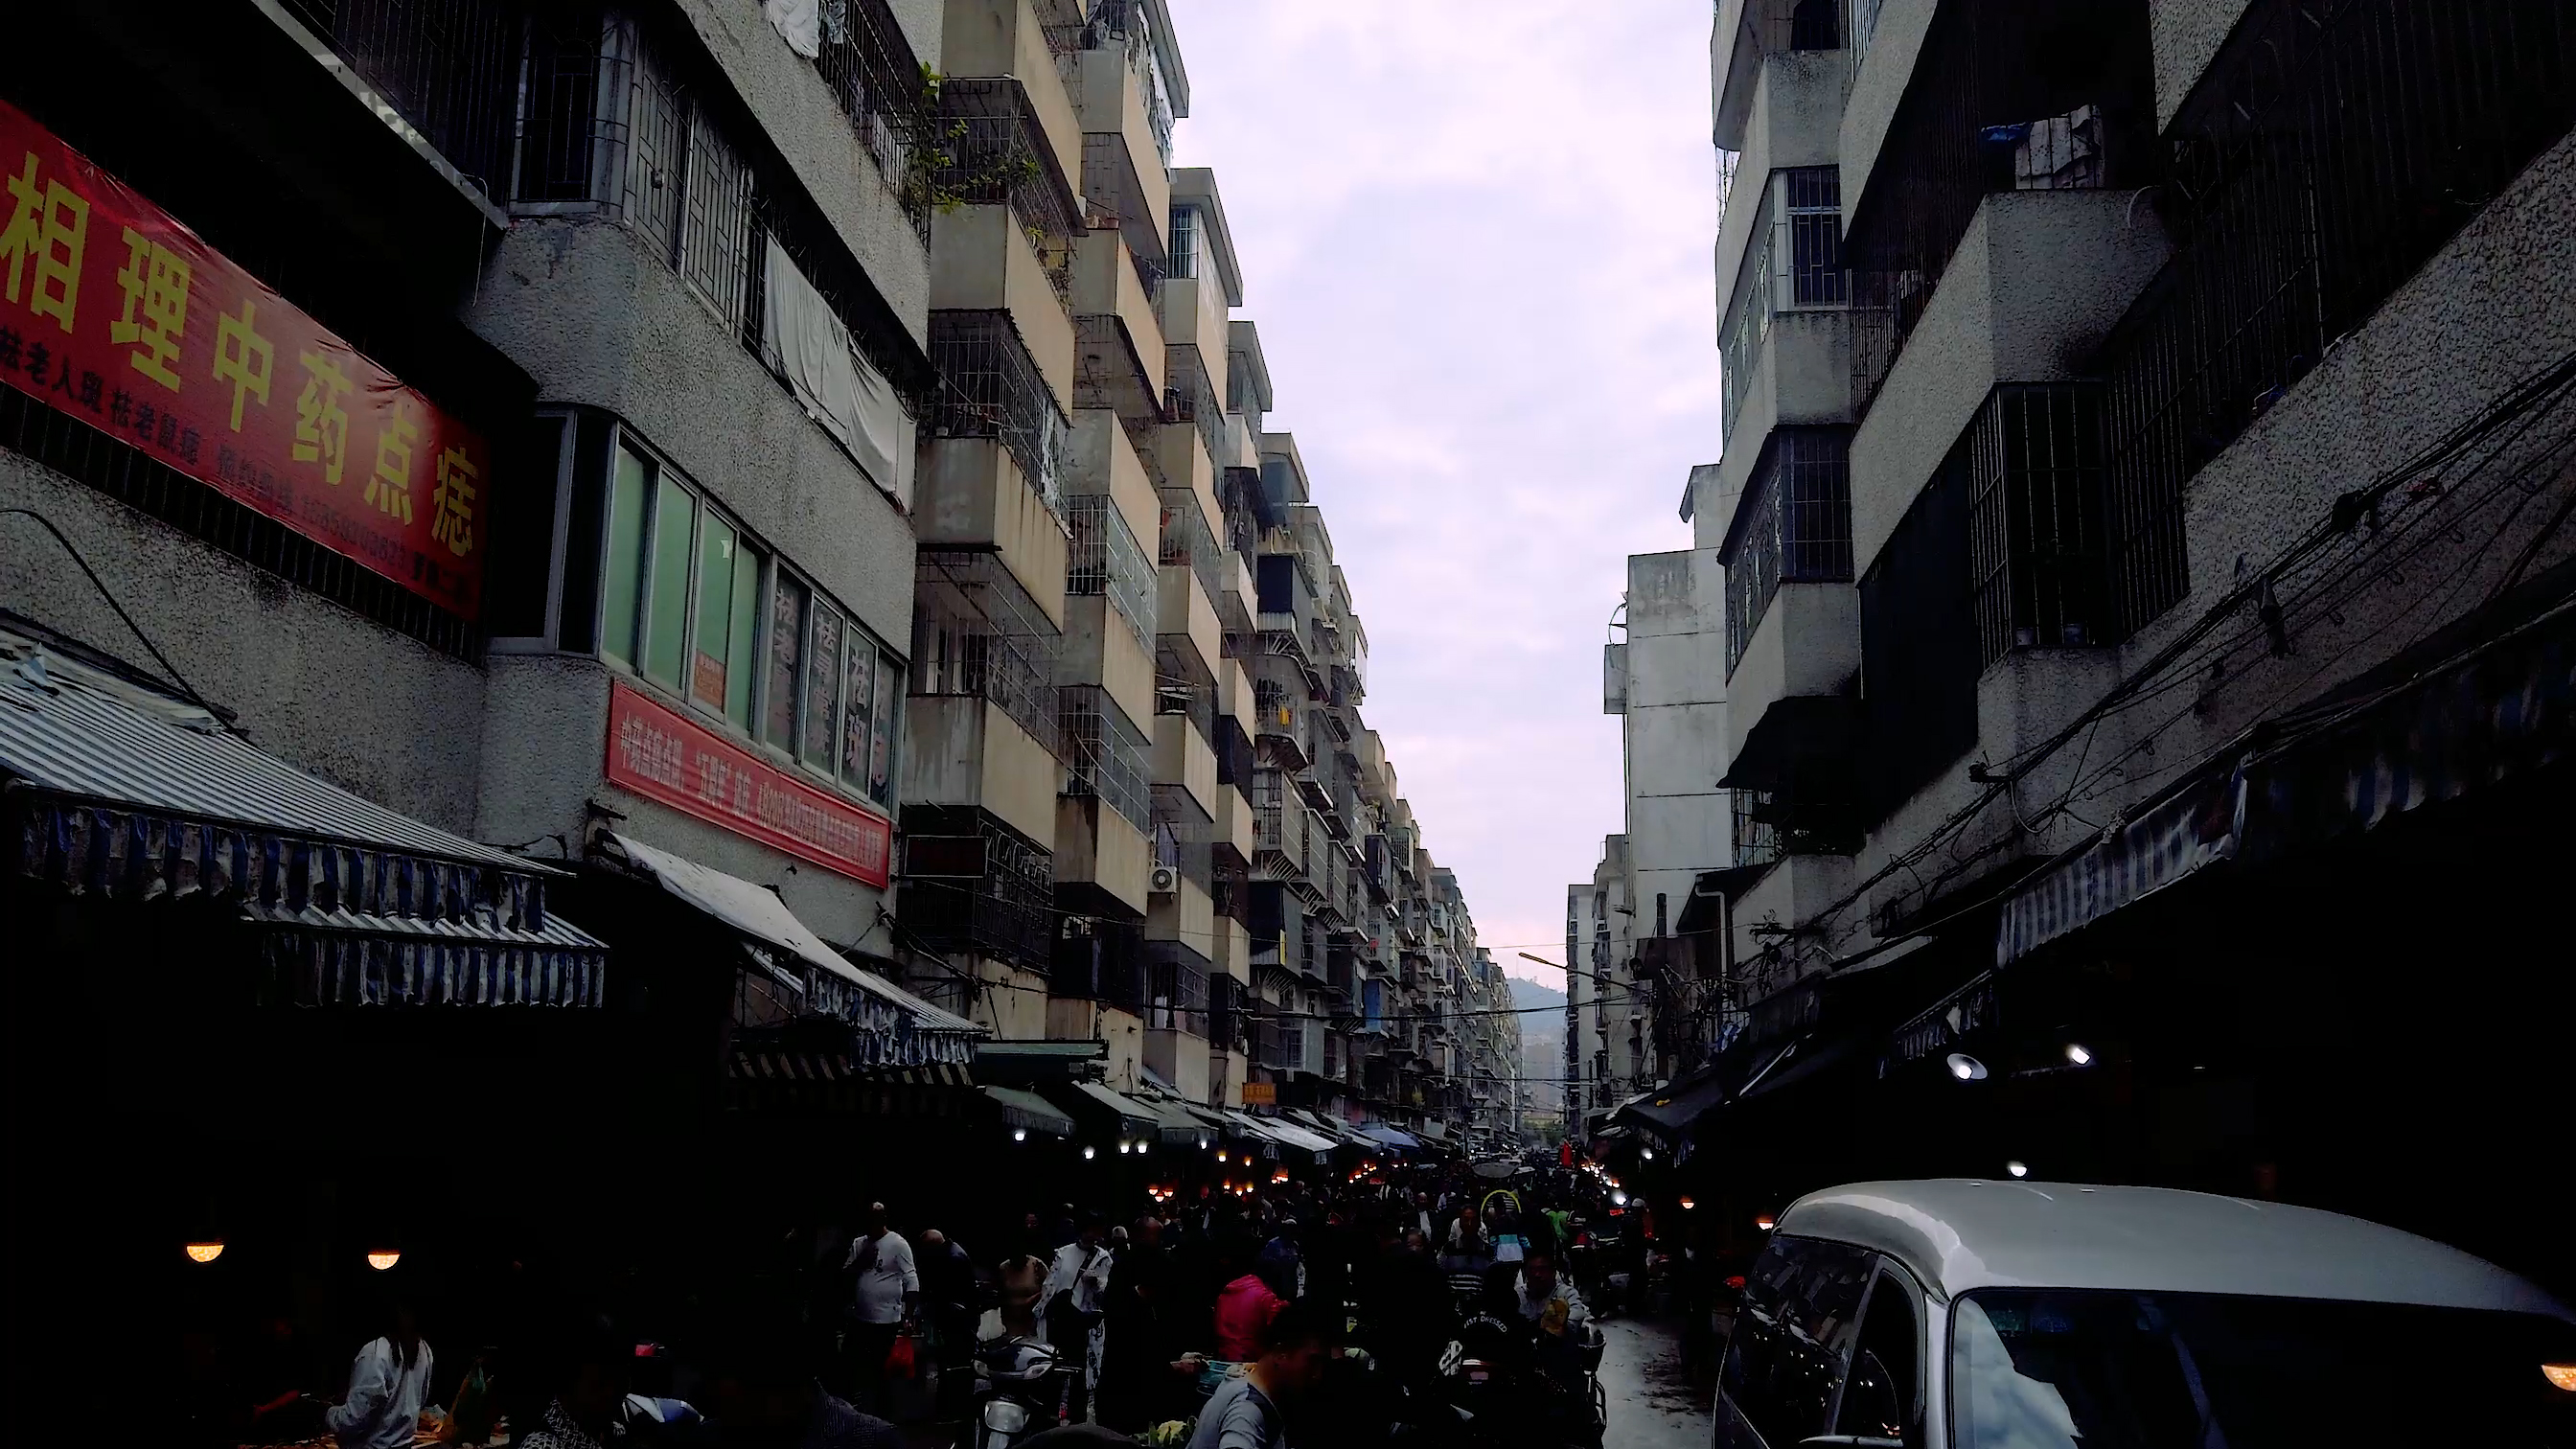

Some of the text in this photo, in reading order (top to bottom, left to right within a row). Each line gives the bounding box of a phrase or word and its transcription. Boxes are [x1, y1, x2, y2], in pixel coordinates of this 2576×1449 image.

[0, 150, 479, 558] 相理中药点痣
[1480, 1315, 1508, 1333] DRESSED
